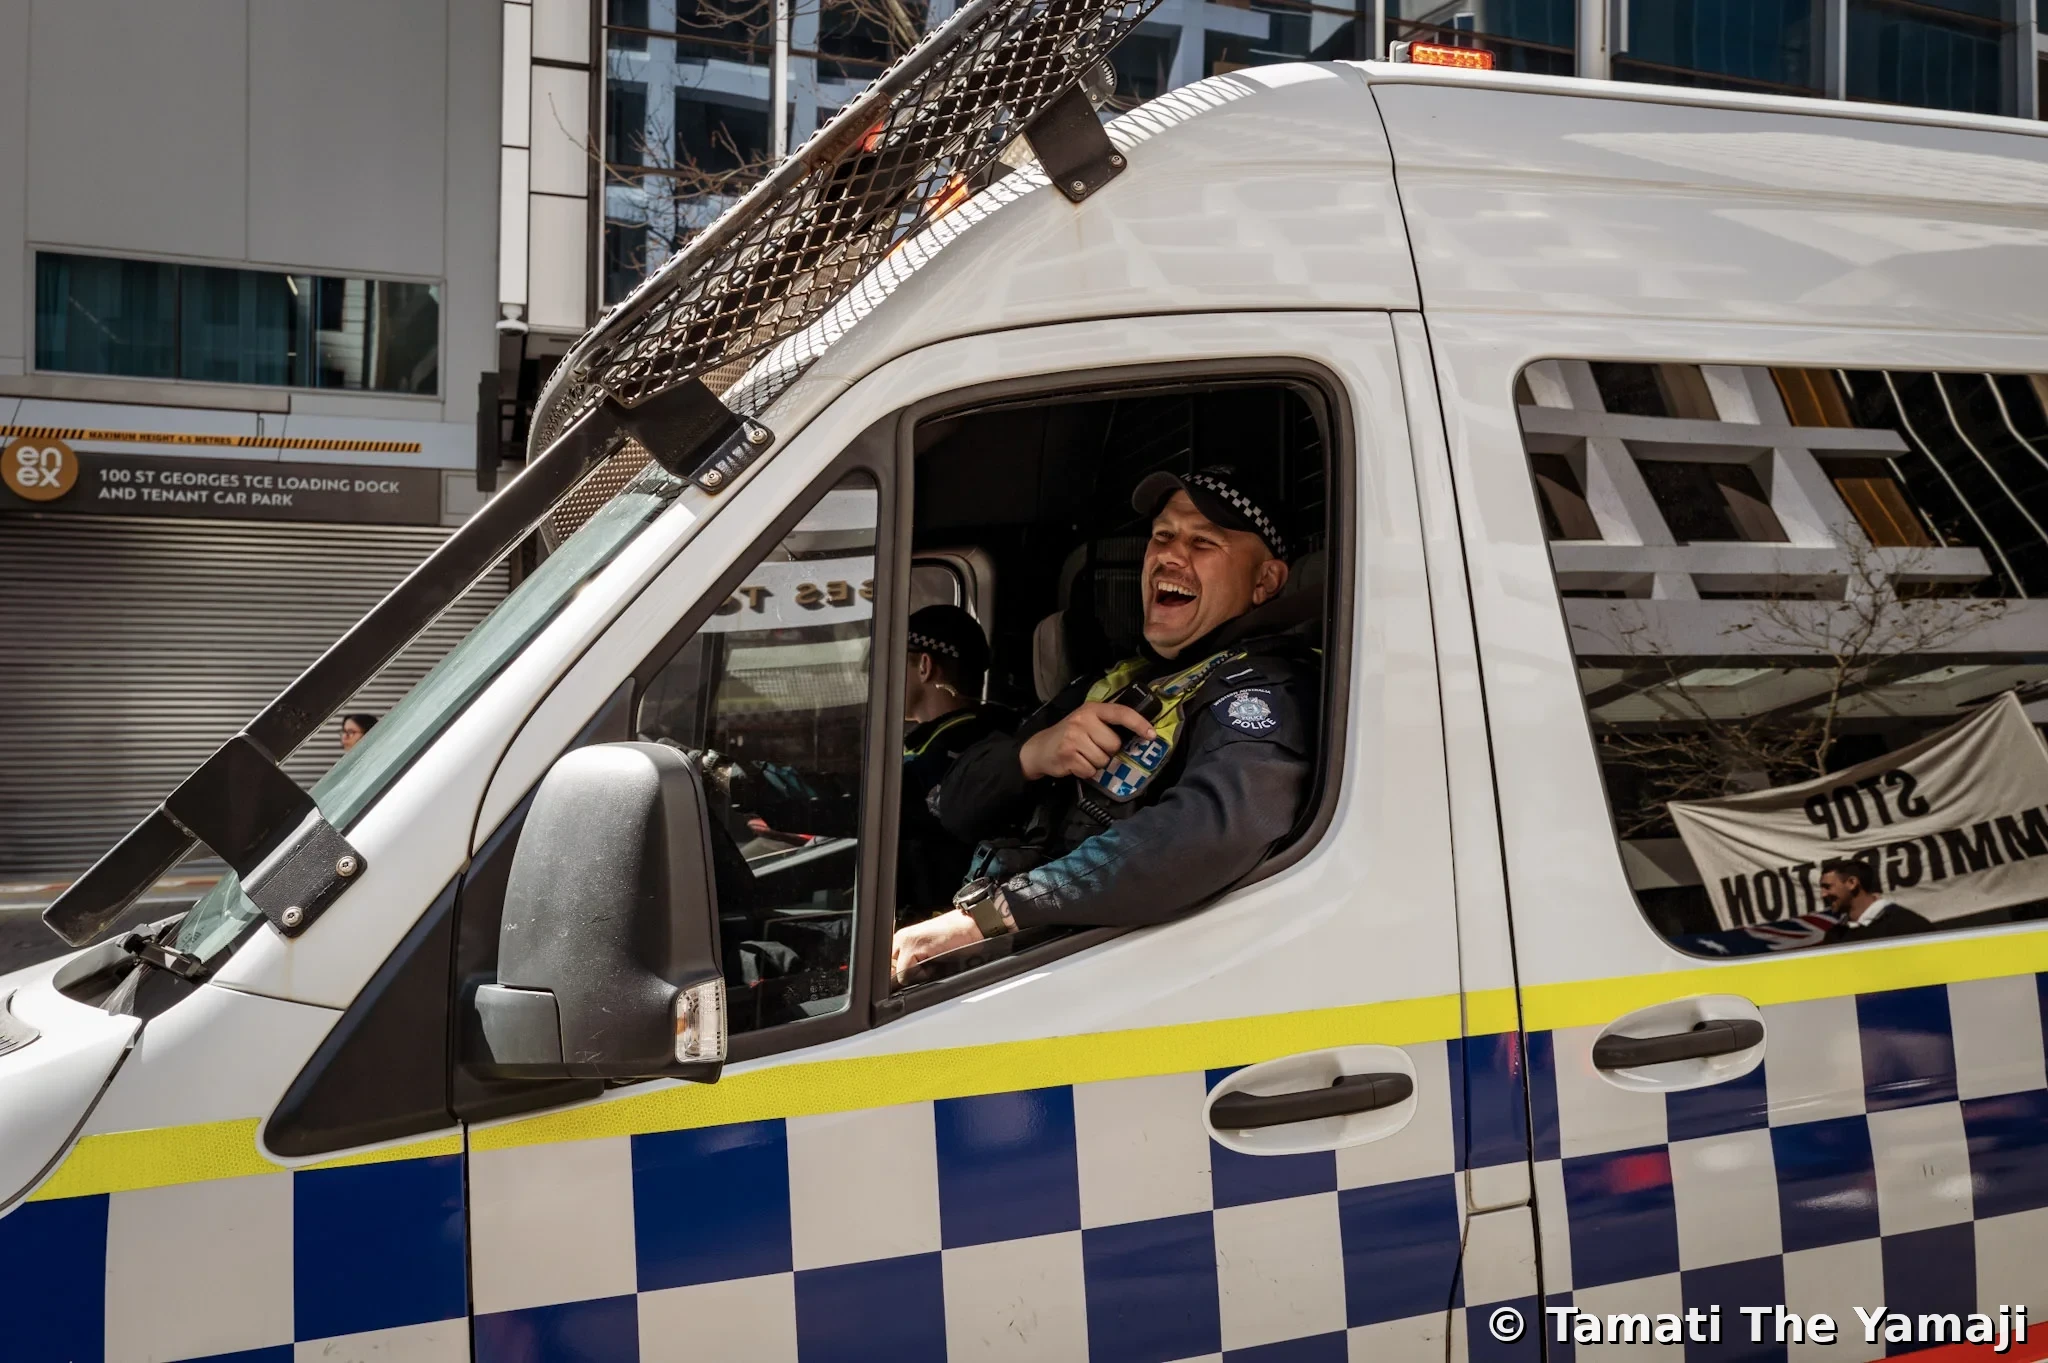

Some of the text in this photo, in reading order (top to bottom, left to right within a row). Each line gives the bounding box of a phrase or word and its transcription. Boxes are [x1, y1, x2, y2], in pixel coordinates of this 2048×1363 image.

[89, 431, 136, 441] MAXIMUM
[140, 433, 175, 442] HEIGHT
[195, 436, 232, 445] METRES
[16, 446, 63, 467] en
[16, 467, 61, 488] ex
[99, 469, 400, 494] 100 ST GEORGES TCE LOADING DOCK
[98, 487, 293, 506] AND TENANT CAR PARK
[1231, 718, 1276, 730] POLICE
